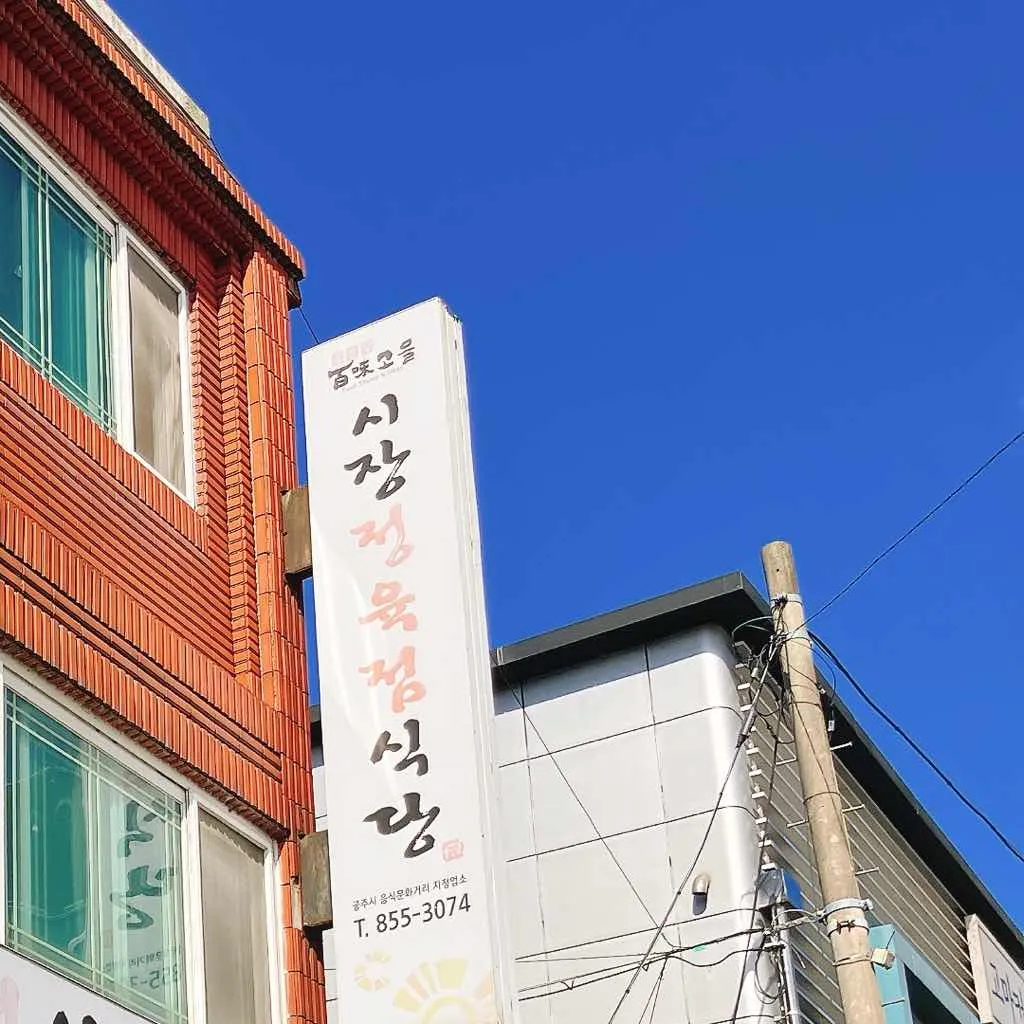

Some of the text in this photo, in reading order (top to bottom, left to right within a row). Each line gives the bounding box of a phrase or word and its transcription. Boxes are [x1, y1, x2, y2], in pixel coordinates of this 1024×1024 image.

[352, 873, 468, 912] 공주시 음식문화거리 지정업소
[353, 892, 471, 938] T. 855-3074
